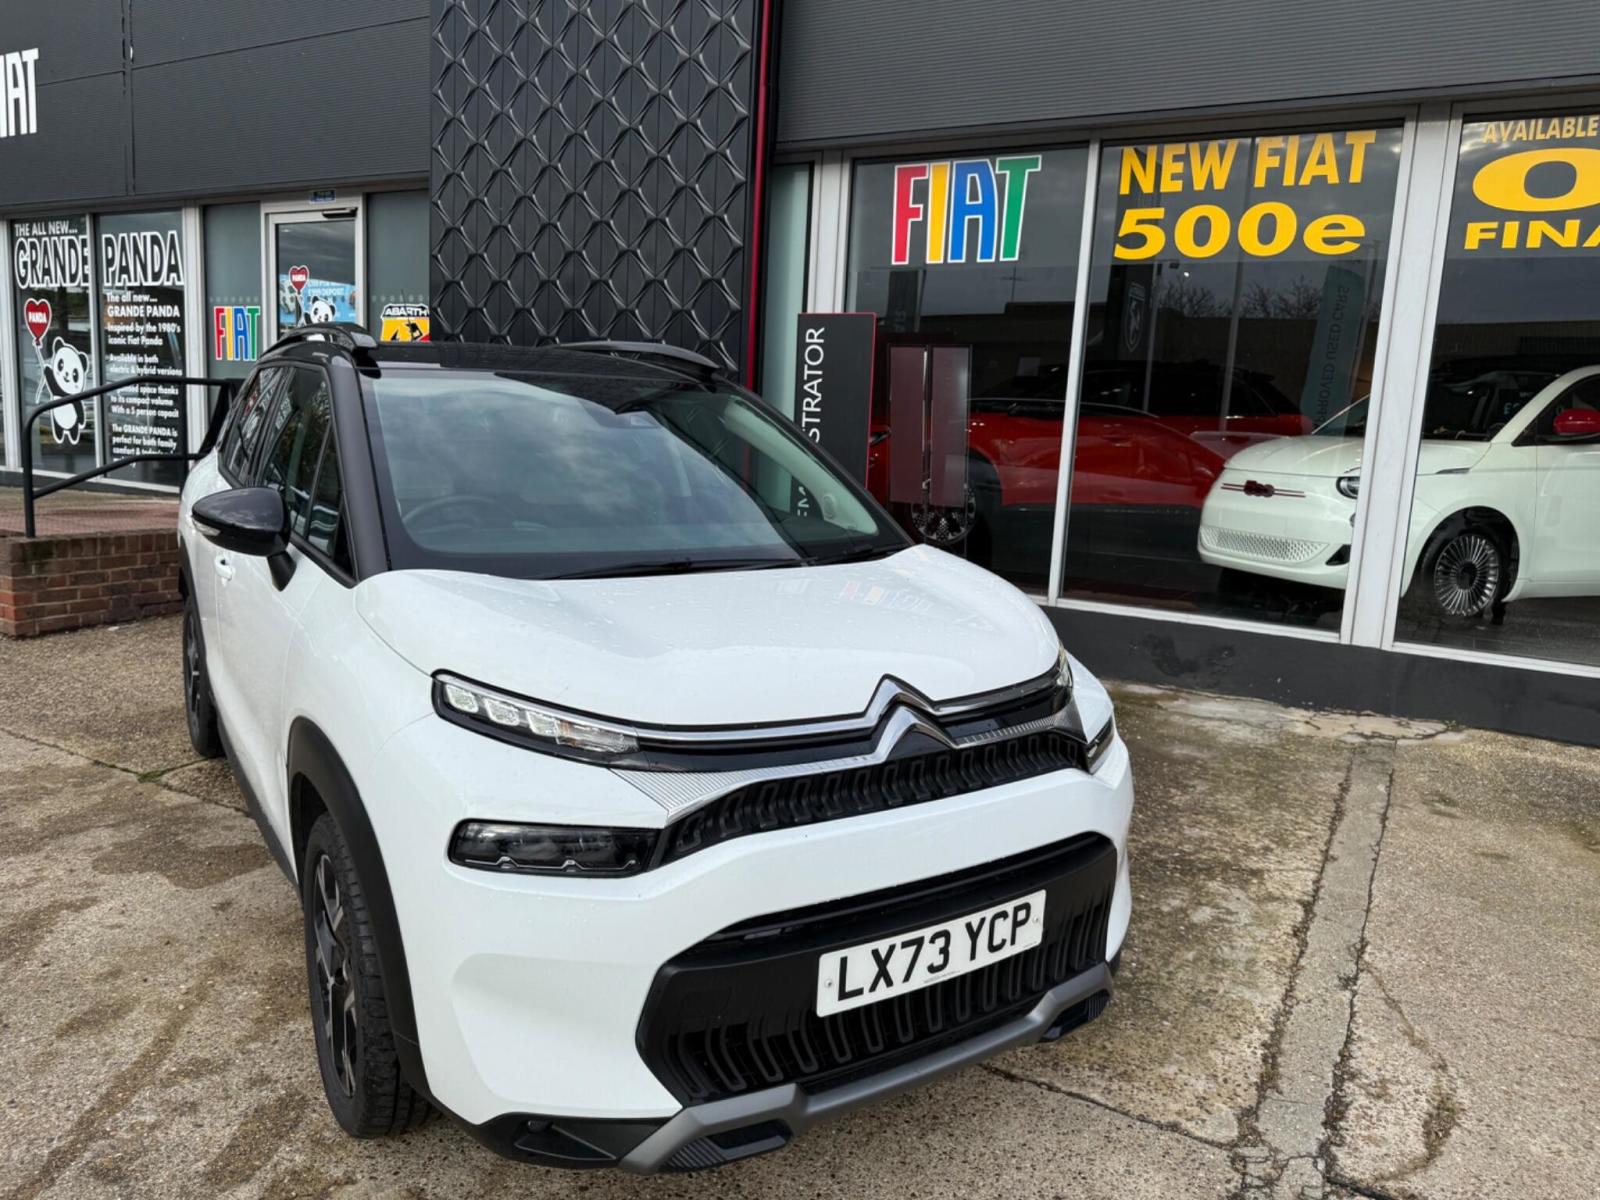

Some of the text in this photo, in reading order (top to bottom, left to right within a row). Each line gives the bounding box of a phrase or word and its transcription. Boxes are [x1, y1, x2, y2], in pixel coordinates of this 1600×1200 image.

[1483, 115, 1600, 143] AVAILABLE
[1119, 130, 1377, 195] NEW FIAT
[891, 155, 1042, 265] FIAT
[15, 223, 30, 237] THE
[32, 222, 46, 235] ALL
[1113, 202, 1366, 260] 500e
[14, 231, 185, 289] GRANDE PANDA
[106, 292, 120, 302] The
[121, 291, 132, 302] all
[107, 304, 180, 317] GRANDE PANDA
[385, 306, 427, 316] ABARTH
[135, 322, 144, 334] by
[146, 322, 157, 332] the
[158, 322, 181, 333] 1980's
[213, 306, 260, 361] FIAT
[128, 335, 140, 345] Fiat
[141, 335, 163, 345] Panda
[136, 365, 156, 376] hybrid
[157, 367, 183, 376] versions
[149, 427, 171, 436] PANDA
[838, 901, 1031, 1002] LX73 YCP
